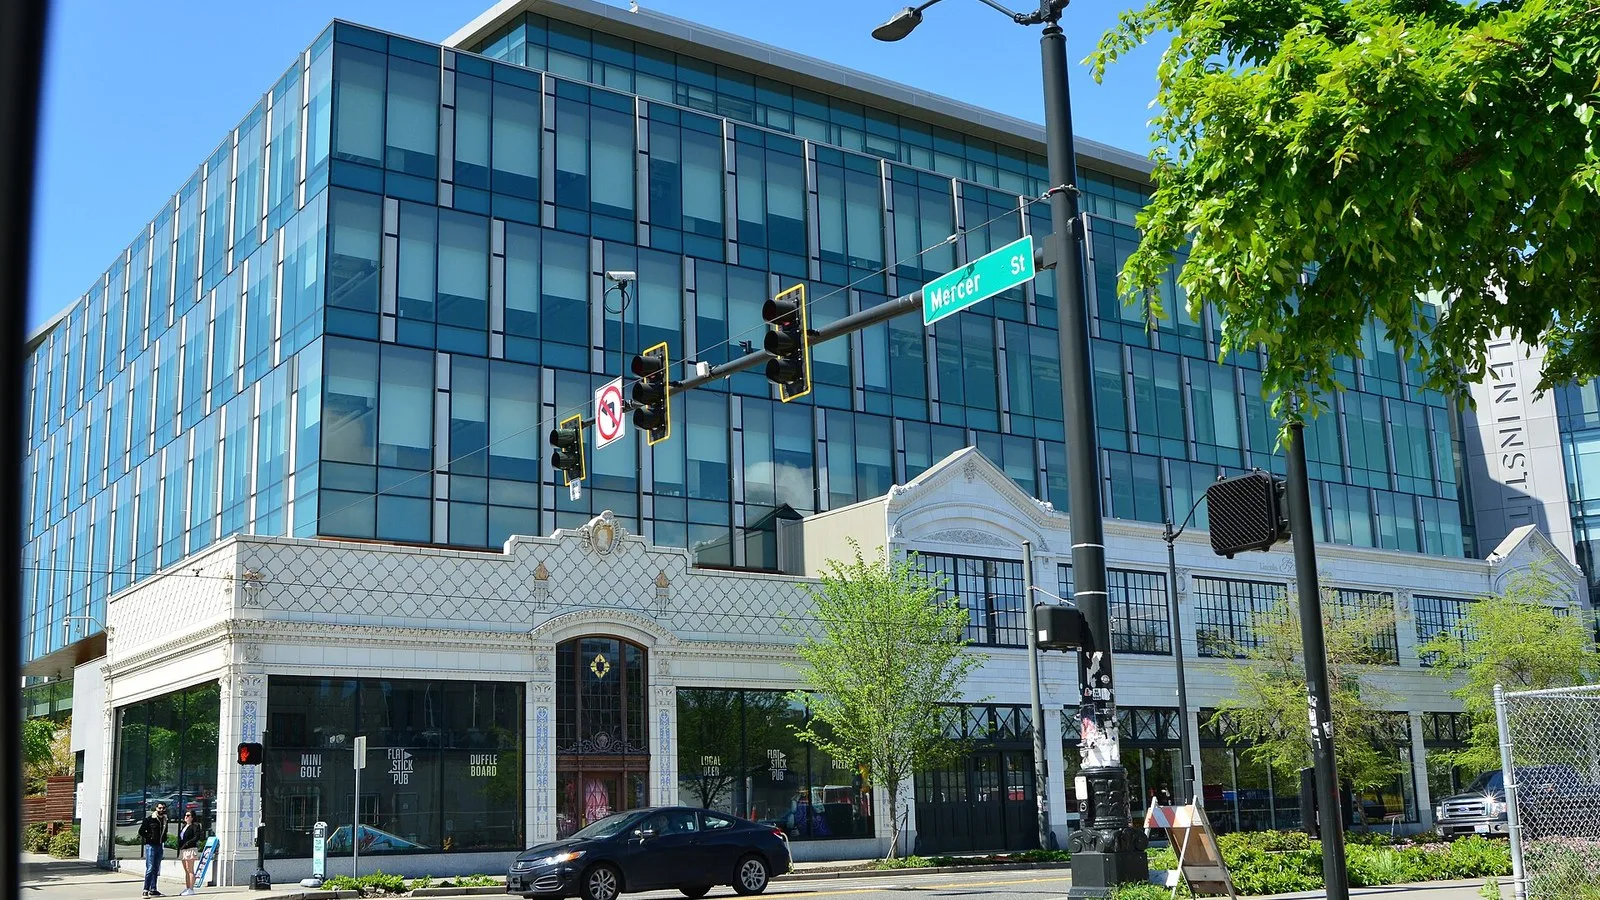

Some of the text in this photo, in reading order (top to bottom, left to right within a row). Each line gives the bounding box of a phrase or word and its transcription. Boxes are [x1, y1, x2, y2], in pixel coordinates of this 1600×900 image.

[931, 253, 1026, 312] Mercer St
[1488, 341, 1534, 524] LEN INSTIT
[301, 754, 322, 766] MINI
[387, 749, 405, 760] FLAT
[470, 754, 498, 766] DUFFLE
[767, 750, 780, 759] FLAT
[392, 760, 413, 771] STICK
[701, 755, 721, 767] LOCAL
[771, 758, 787, 769] STICK
[300, 766, 322, 778] GOLF
[470, 765, 498, 777] BOARD
[703, 766, 720, 777] BEER
[772, 770, 784, 781] PUB
[393, 773, 409, 785] PUB
